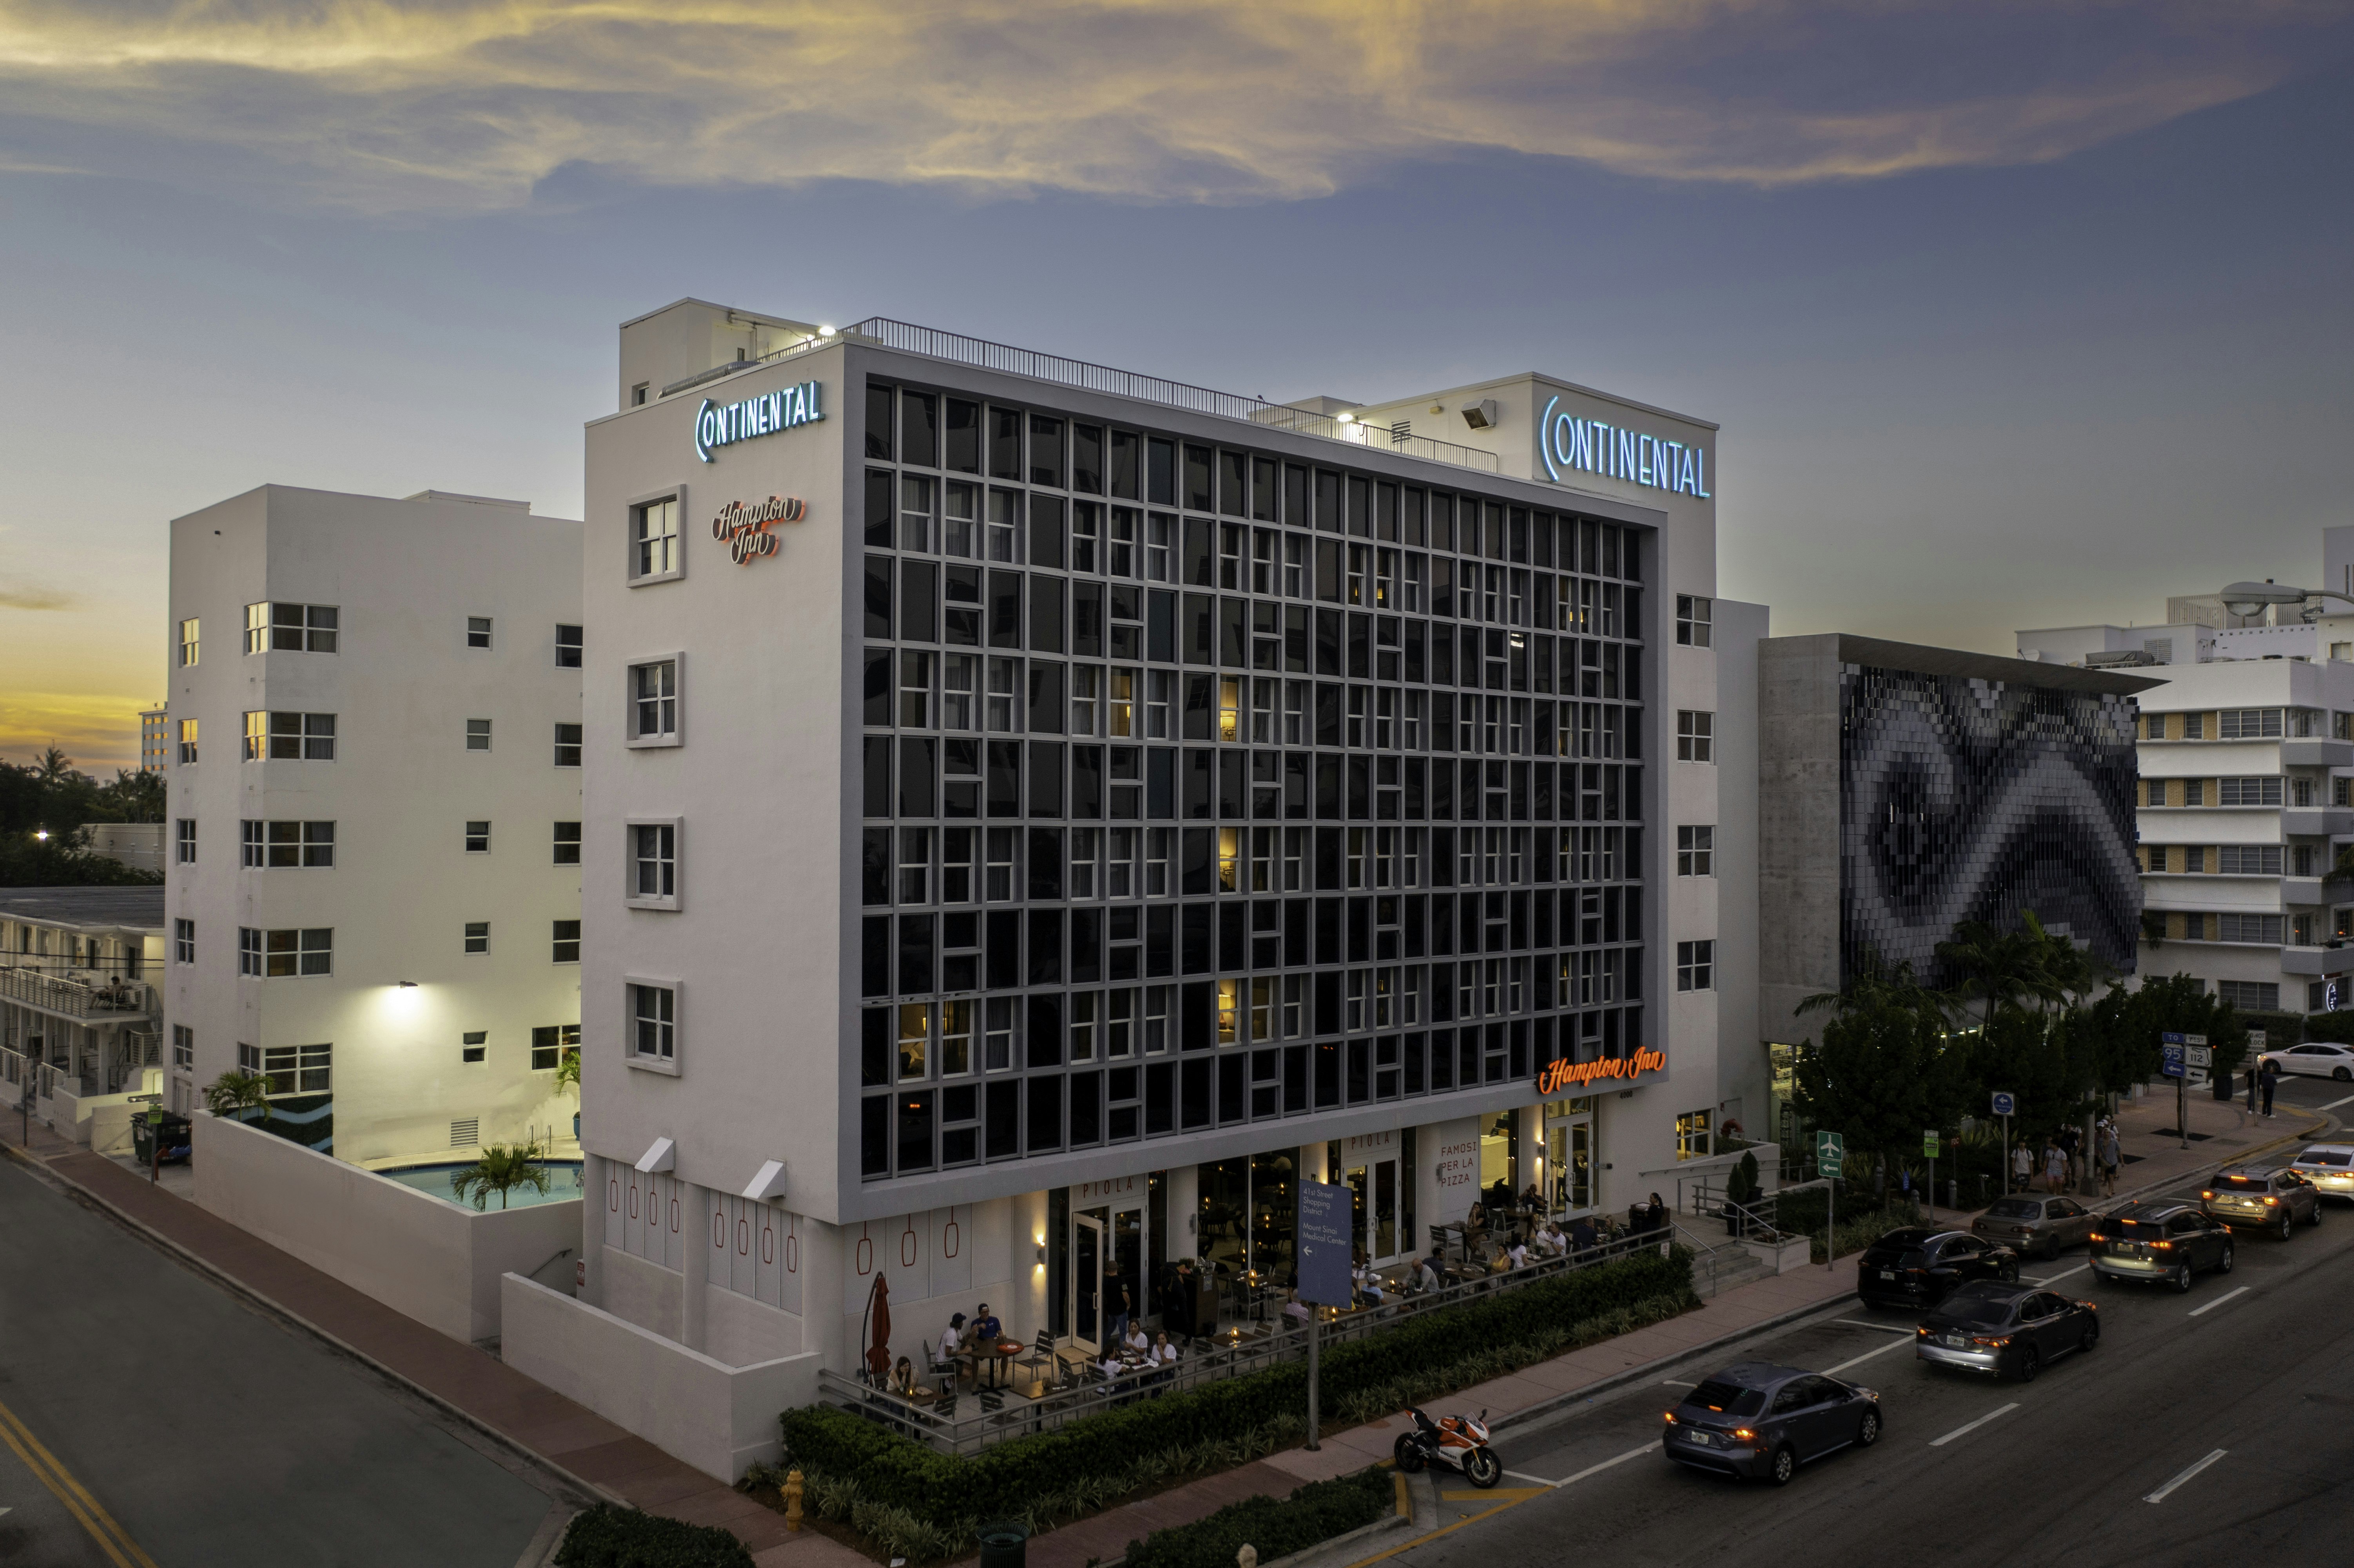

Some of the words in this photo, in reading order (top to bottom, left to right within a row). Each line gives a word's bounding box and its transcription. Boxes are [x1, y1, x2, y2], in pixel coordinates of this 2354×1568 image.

[695, 381, 823, 463] CONTINENTAL
[1538, 395, 1710, 498] CONTINENTAL
[711, 497, 798, 540] Hampton
[731, 527, 771, 564] Inn
[2165, 1048, 2181, 1060] 95
[1540, 1056, 1627, 1094] Hampton
[1629, 1046, 1665, 1079] Inn
[1620, 1090, 1632, 1099] 4000
[1352, 1131, 1389, 1149] PIOLA
[1442, 1142, 1476, 1157] FAMOSI
[1442, 1160, 1458, 1171] PER
[1463, 1158, 1473, 1167] LA
[1084, 1176, 1132, 1198] PIOLA
[1442, 1173, 1470, 1187] PIZZA
[1317, 1189, 1333, 1198] Street
[1303, 1196, 1330, 1210] Shopping
[1303, 1205, 1322, 1215] District
[1303, 1222, 1320, 1232] Mount
[1323, 1225, 1337, 1234] Sinai
[1303, 1231, 1325, 1242] Medical
[1327, 1236, 1346, 1245] Center
